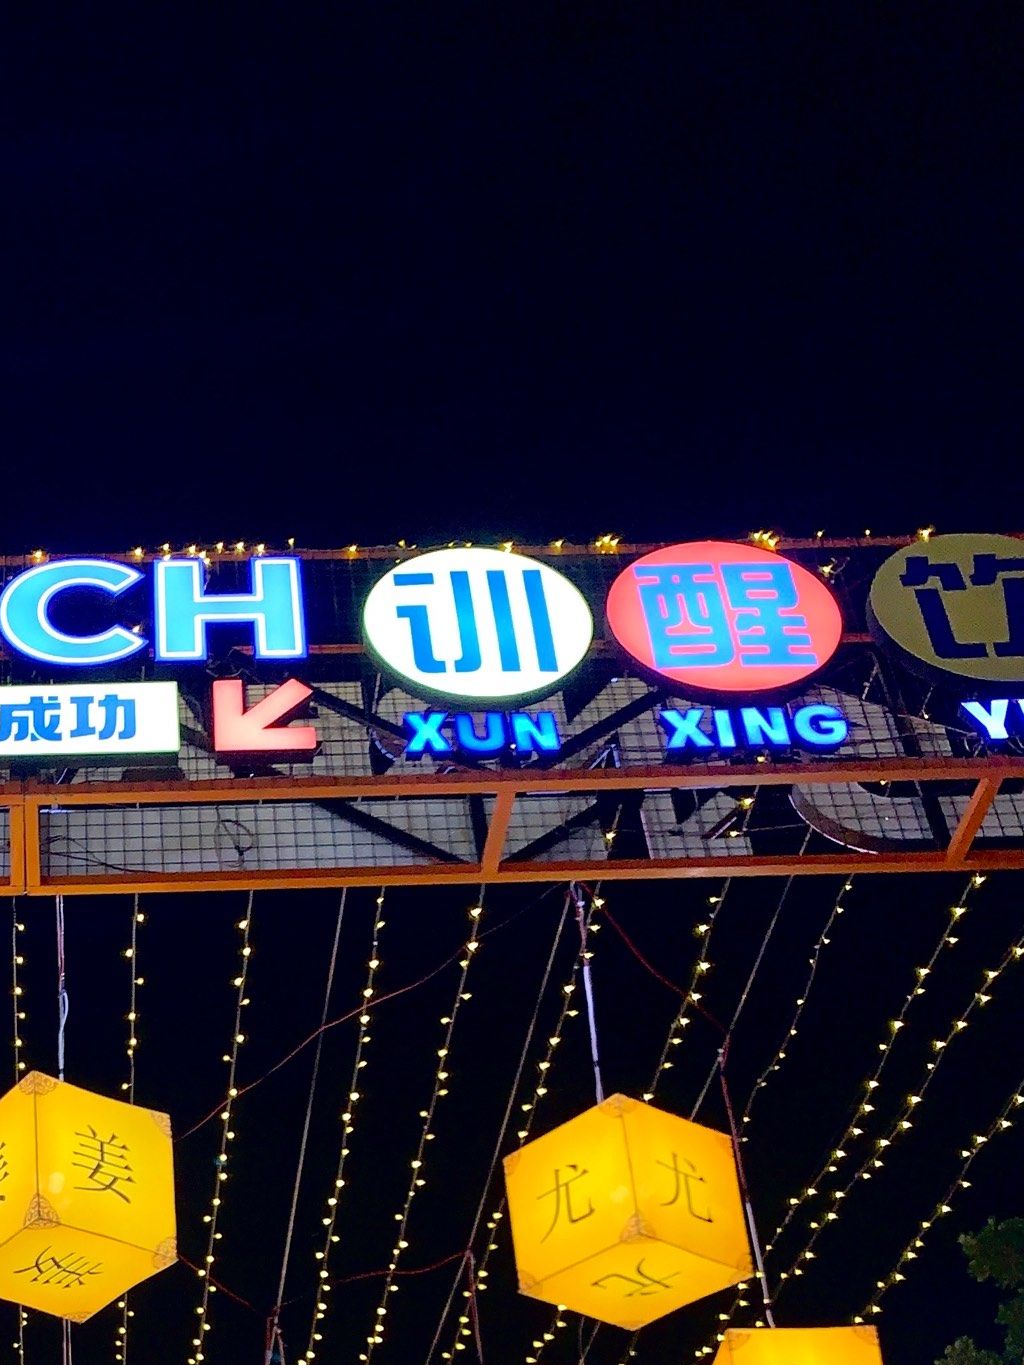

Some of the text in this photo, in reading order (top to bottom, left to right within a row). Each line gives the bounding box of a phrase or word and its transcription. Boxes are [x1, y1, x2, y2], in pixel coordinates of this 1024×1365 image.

[634, 562, 820, 669] 醒
[404, 711, 563, 754] XUN
[662, 704, 850, 749] XING
[71, 1123, 136, 1204] 姜
